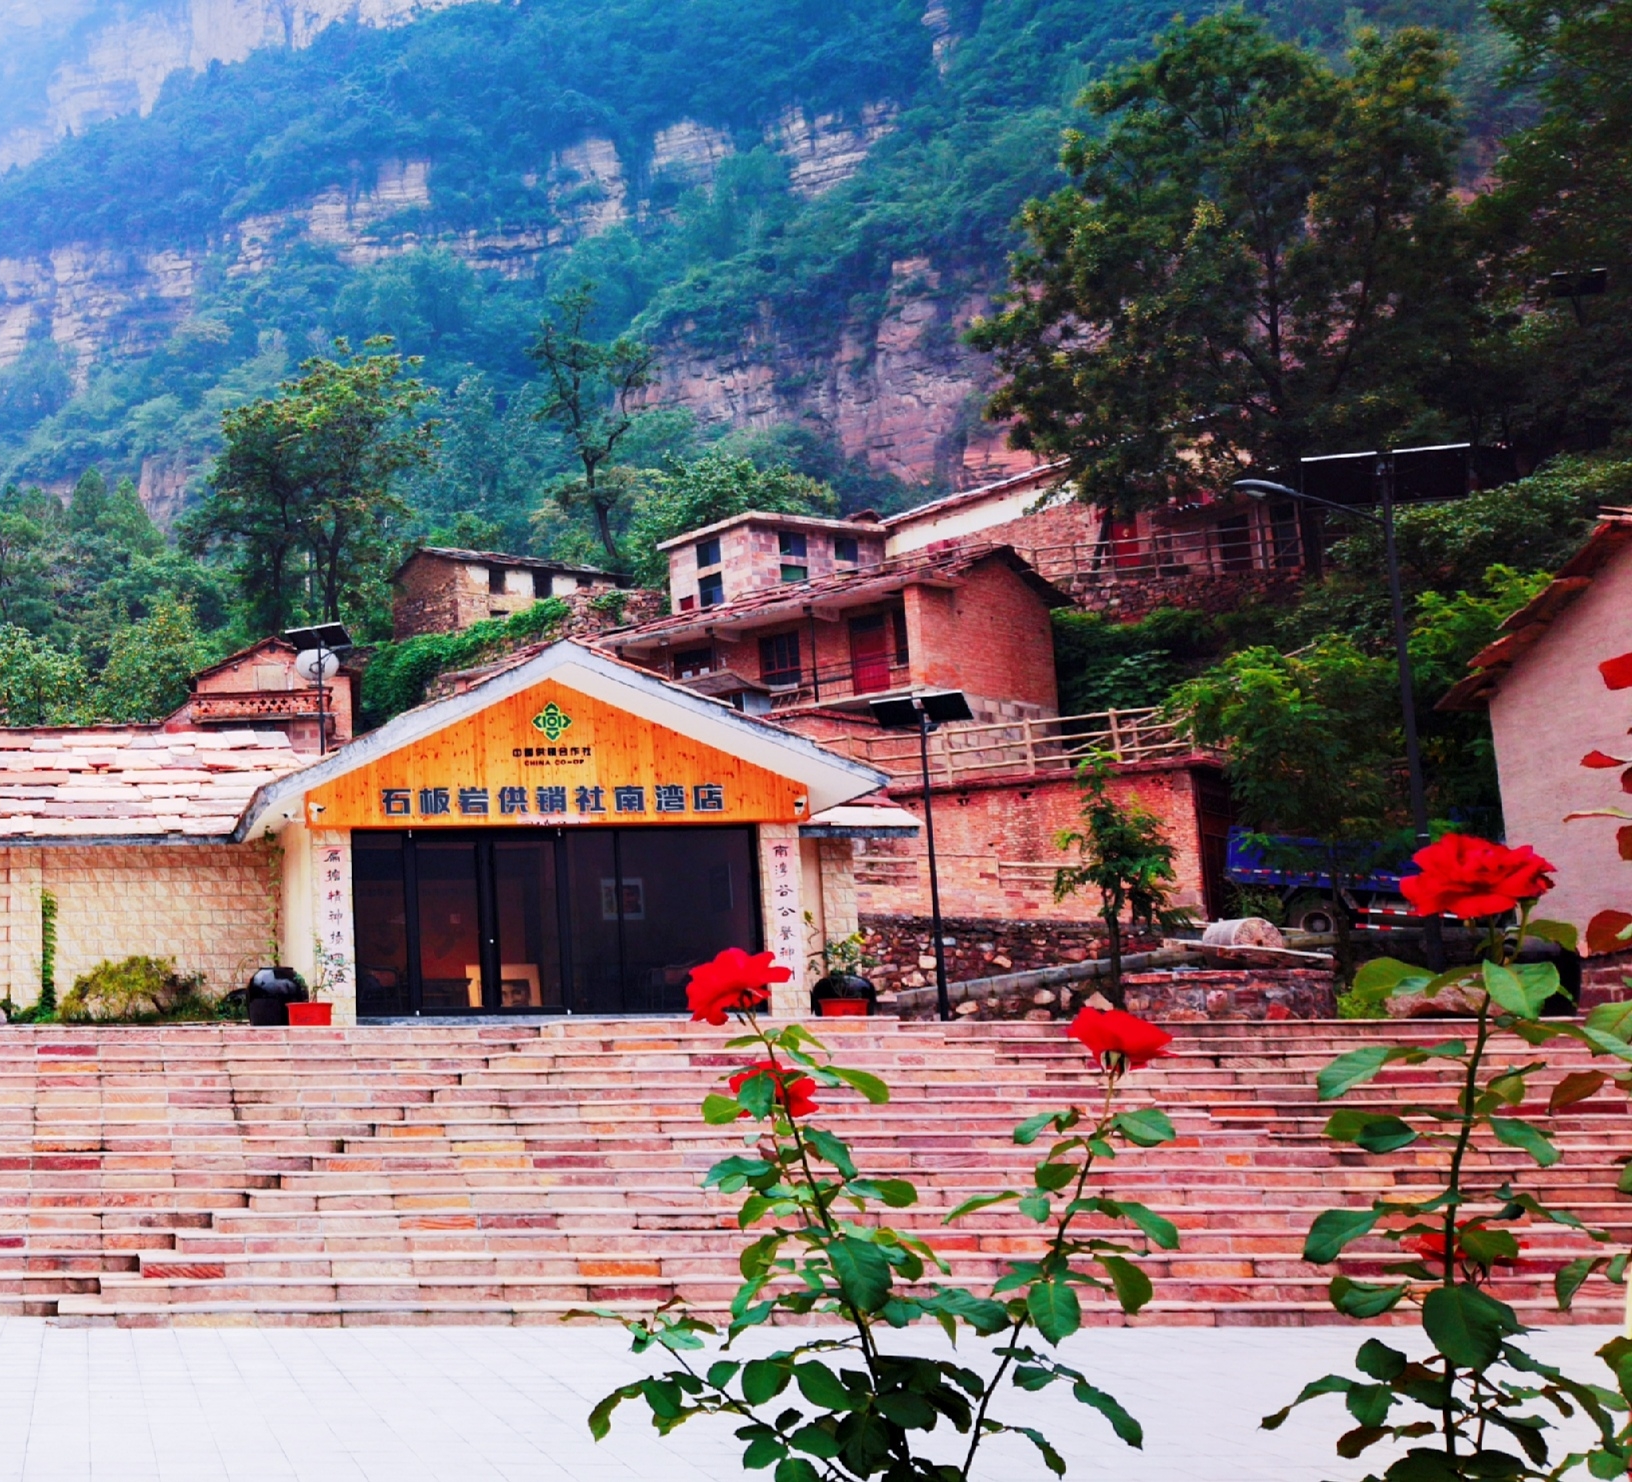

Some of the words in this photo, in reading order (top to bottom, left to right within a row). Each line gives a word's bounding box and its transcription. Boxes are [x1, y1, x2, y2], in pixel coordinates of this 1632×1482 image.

[381, 784, 724, 815] 石板岩供销社南湾店
